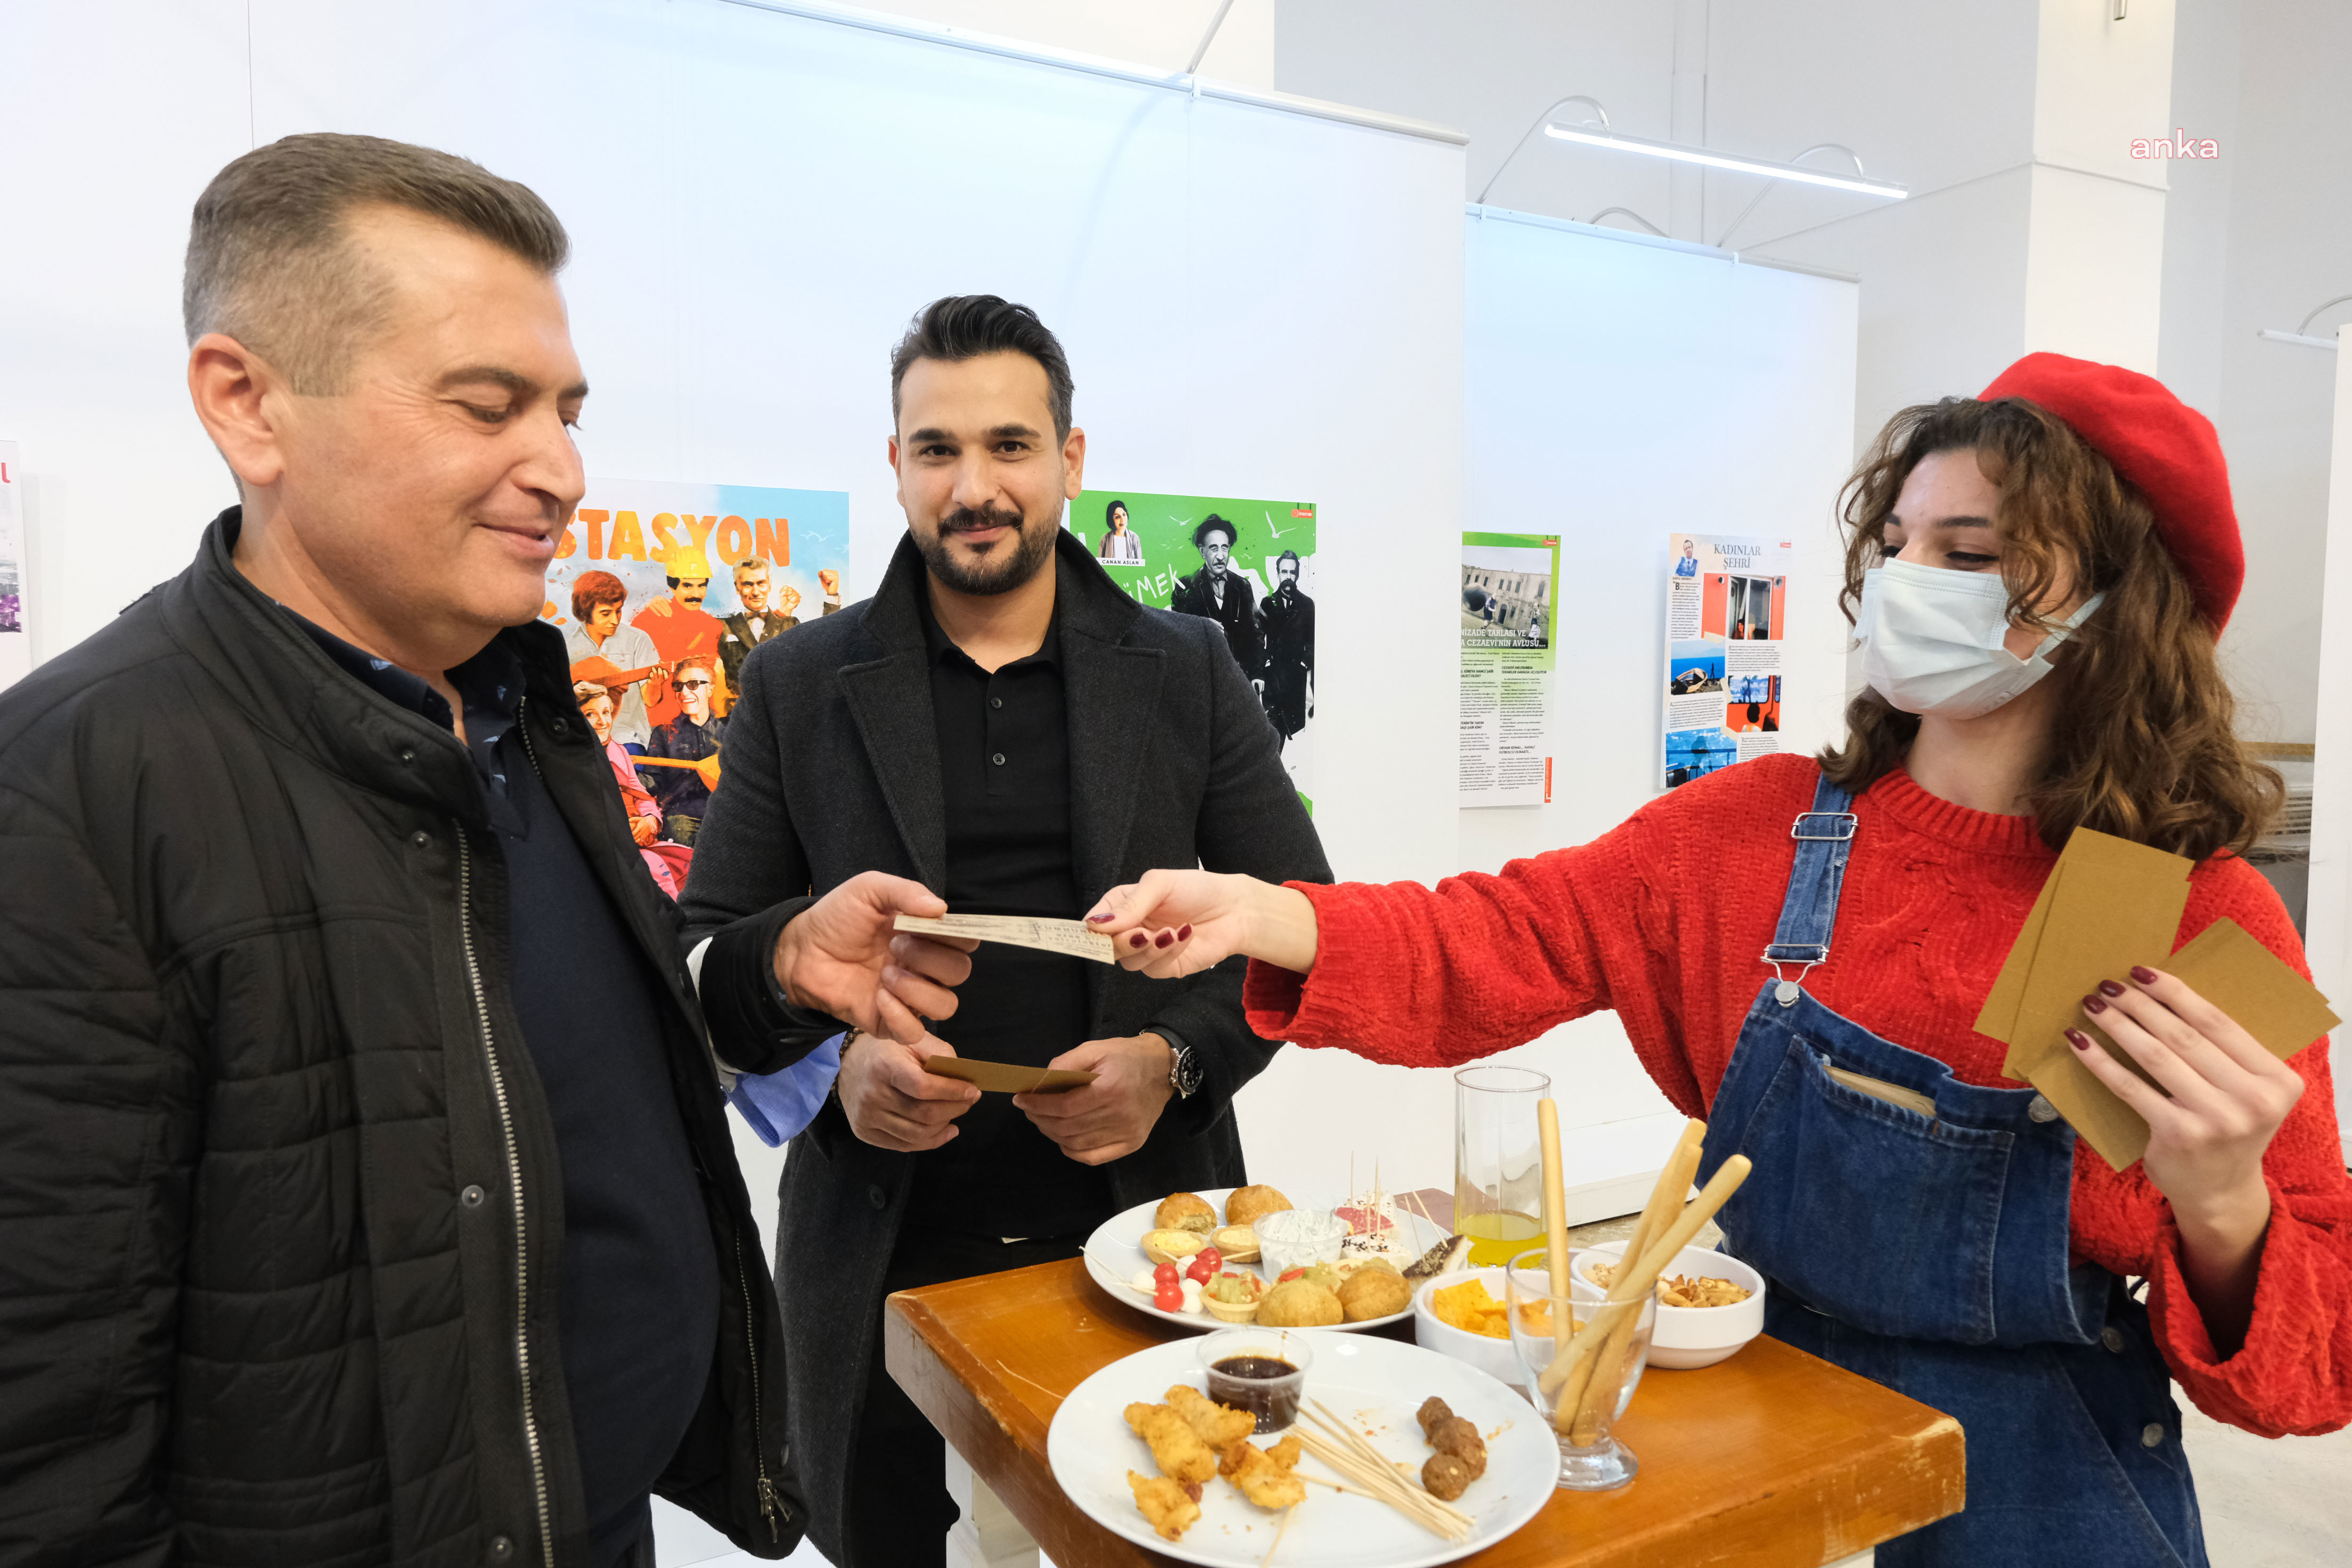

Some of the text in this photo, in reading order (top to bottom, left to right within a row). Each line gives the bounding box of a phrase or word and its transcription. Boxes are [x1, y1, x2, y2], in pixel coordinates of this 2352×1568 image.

[1714, 544, 1761, 556] KADINLAR
[1724, 557, 1750, 570] ŞEHRİ
[1123, 563, 1186, 604] MEK
